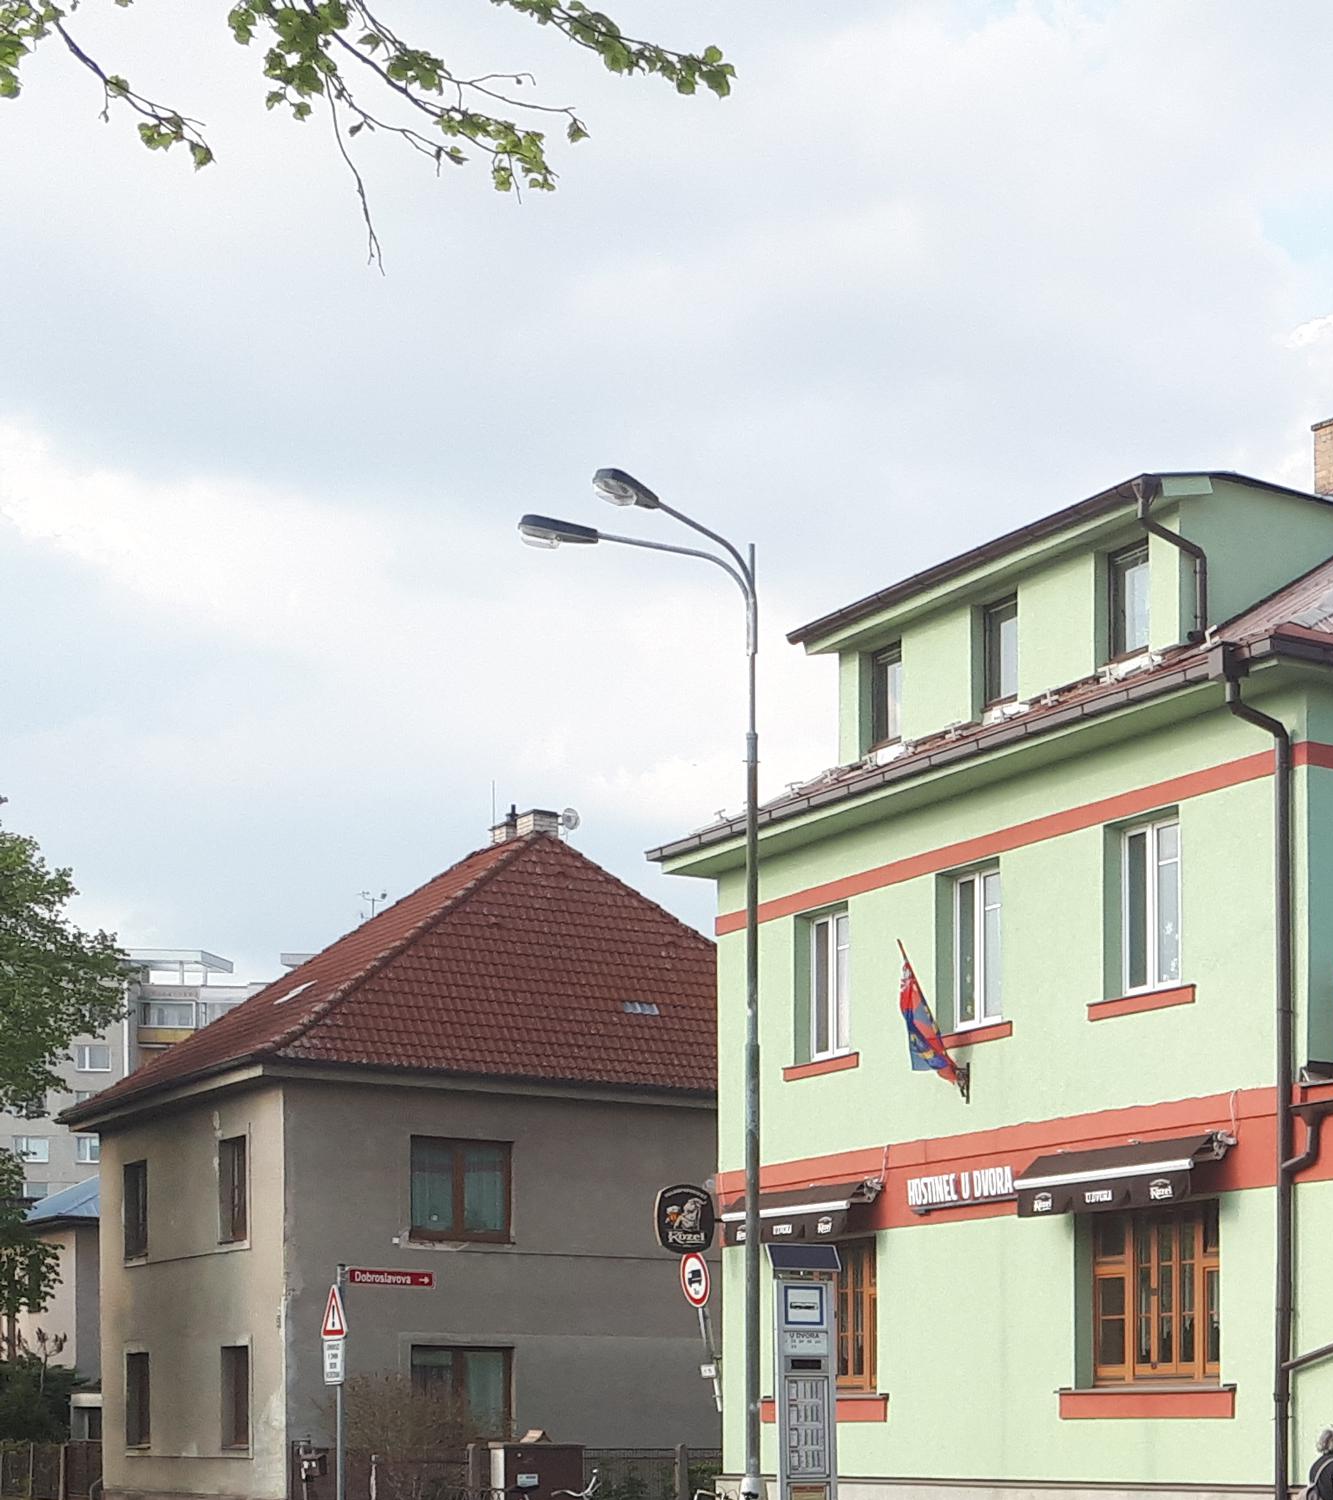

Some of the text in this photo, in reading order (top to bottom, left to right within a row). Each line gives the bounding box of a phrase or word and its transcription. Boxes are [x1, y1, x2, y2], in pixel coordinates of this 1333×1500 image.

[907, 1166, 1014, 1206] HOSTINEC U DVORA
[668, 1231, 705, 1245] Kozel
[354, 1271, 412, 1284] Dobroslavova
